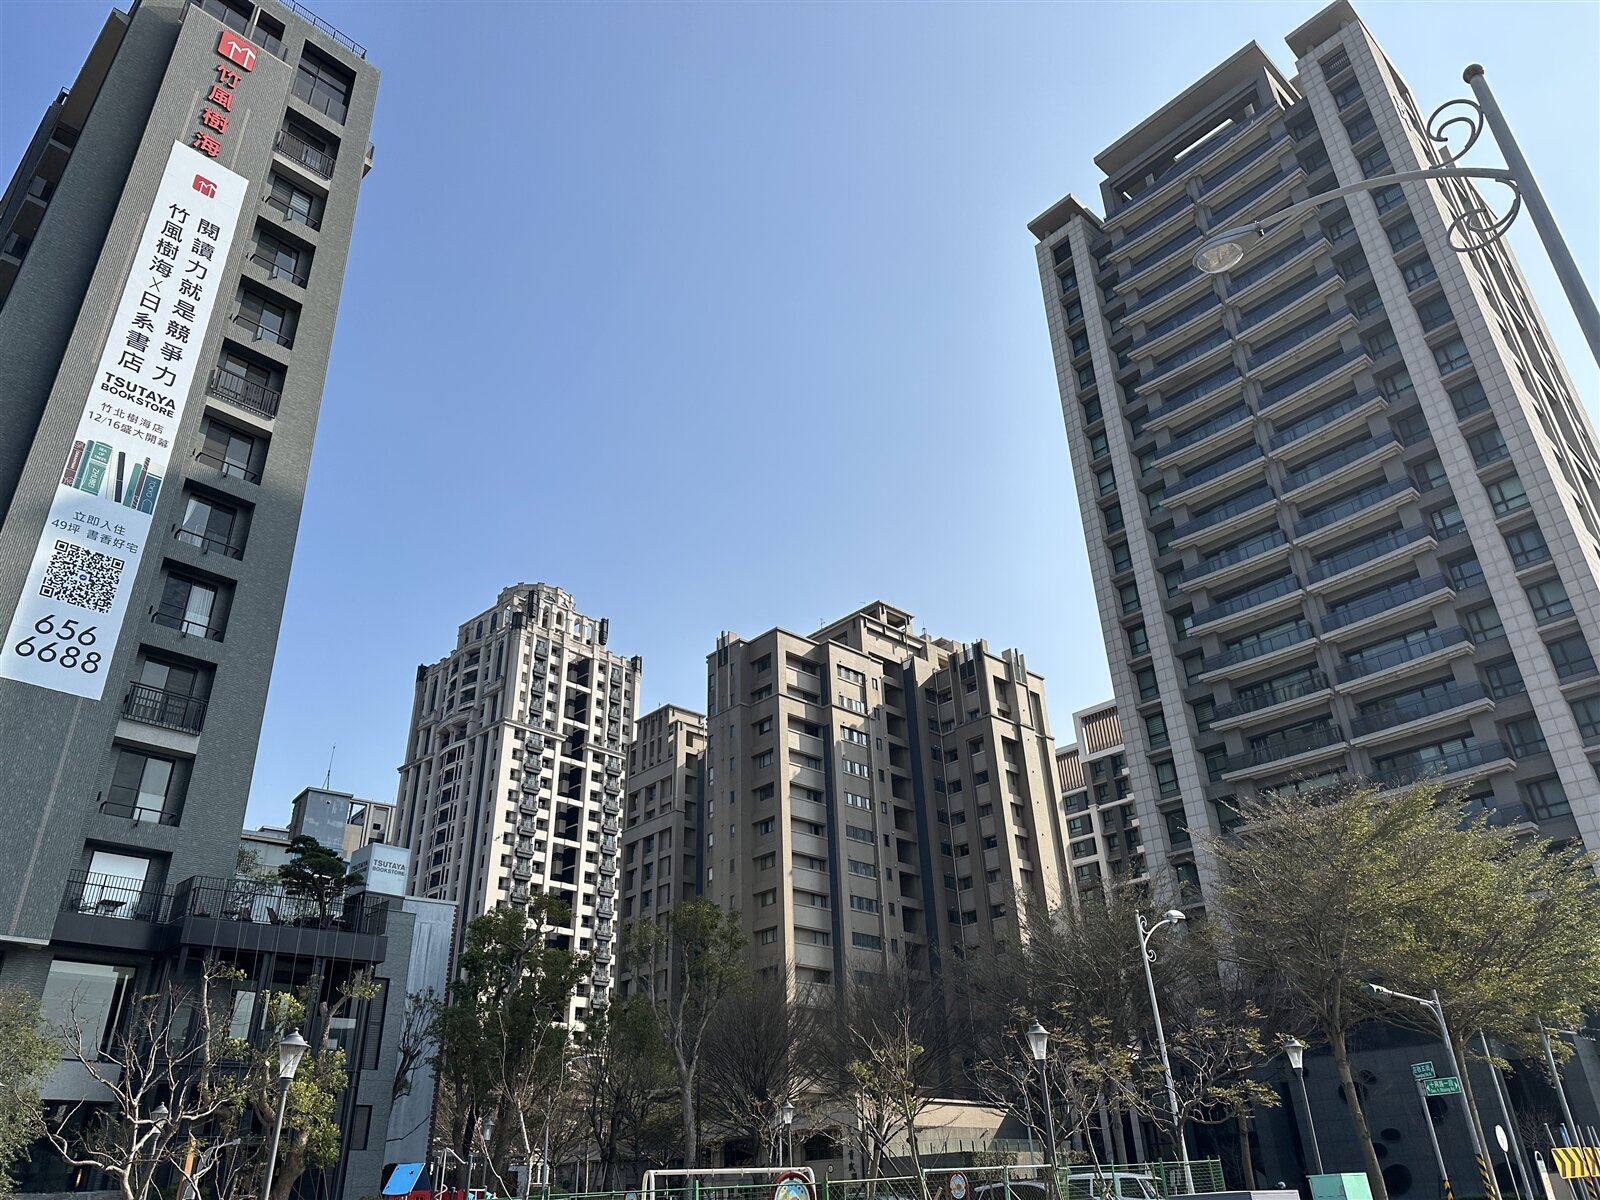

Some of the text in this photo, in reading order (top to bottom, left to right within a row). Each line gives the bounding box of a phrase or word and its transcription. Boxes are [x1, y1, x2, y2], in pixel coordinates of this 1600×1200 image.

[193, 63, 241, 157] 竹風樹海
[152, 217, 221, 388] 閱讀力就是競爭力
[101, 383, 175, 418] BOOKSTORE
[105, 372, 176, 410] TSUTAYA
[89, 411, 169, 448] 12/16盛大開幕
[101, 402, 164, 434] 竹北樹海店
[88, 467, 100, 489] ZHUBEI
[145, 480, 156, 498] TOKYO
[51, 519, 138, 553] 49坪 書香好宅
[73, 511, 126, 536] 立即入住
[34, 614, 98, 646] 656
[15, 636, 102, 674] 6688
[372, 866, 405, 876] BOOKSTORE
[373, 859, 406, 871] TSUTAYA
